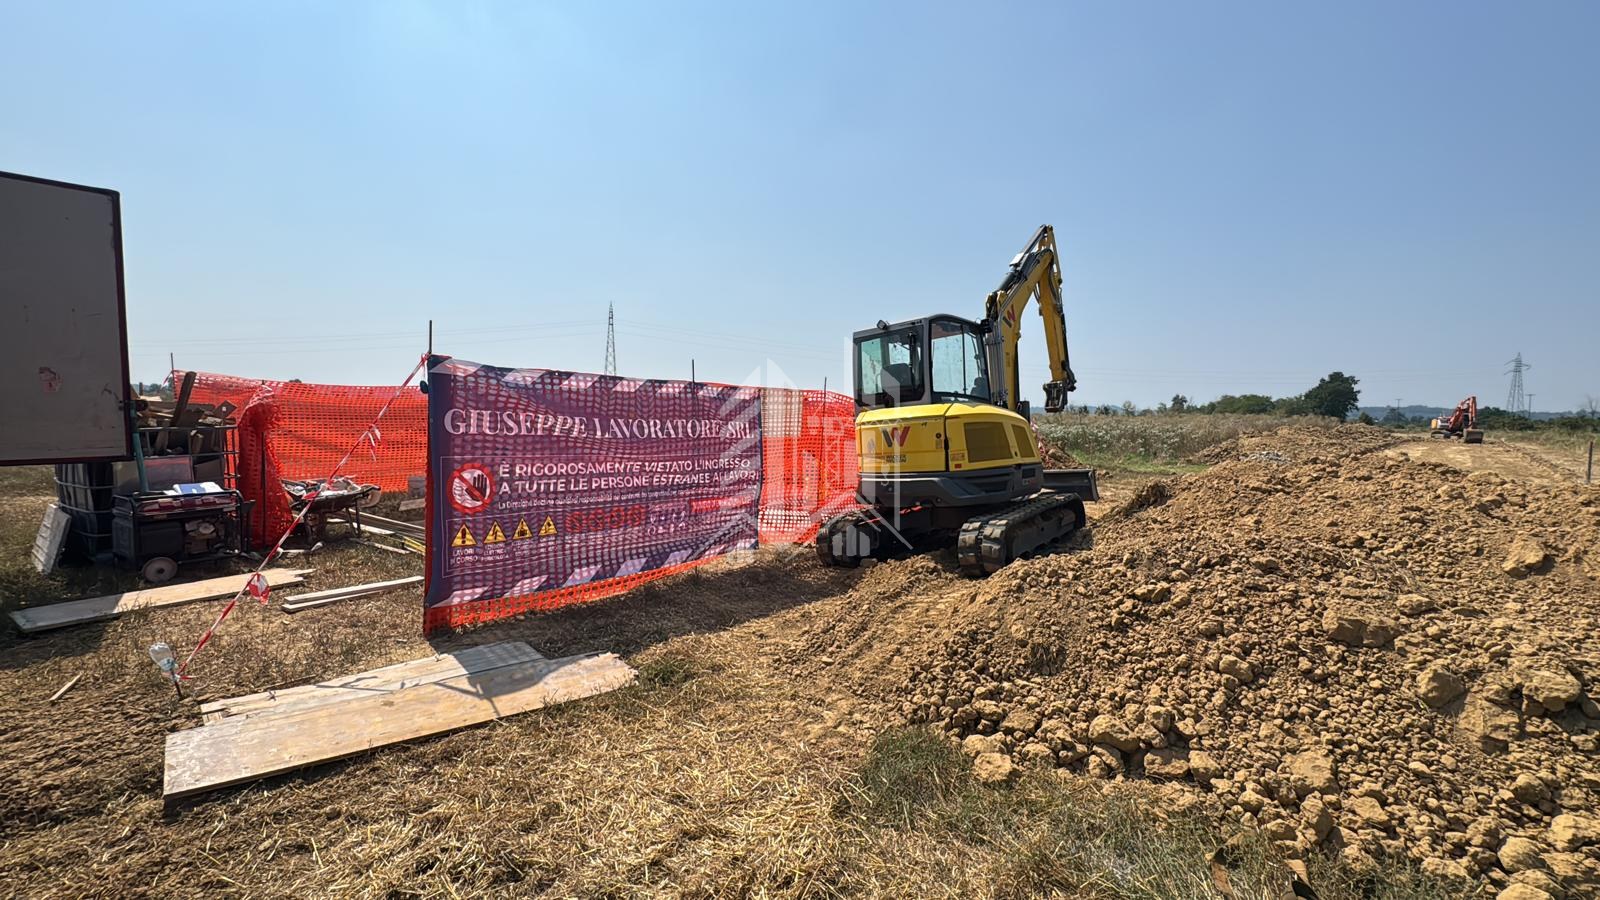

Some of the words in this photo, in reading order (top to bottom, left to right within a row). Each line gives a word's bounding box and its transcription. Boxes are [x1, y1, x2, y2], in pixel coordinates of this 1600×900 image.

[443, 408, 588, 438] GIUSEPPE
[593, 417, 722, 439] LAVORATORE
[726, 421, 754, 439] SRL
[499, 461, 511, 477] È
[515, 461, 641, 477] RIGOROSAMENTE
[644, 460, 693, 473] VIETATO
[695, 458, 751, 471] L'INGRESSO
[499, 483, 512, 495] A
[514, 479, 566, 493] TUTTE
[570, 478, 588, 491] LE
[591, 475, 650, 489] PERSONE
[653, 473, 710, 486] ESTRANEE
[713, 472, 722, 482] AI
[724, 470, 760, 481] LAVORI
